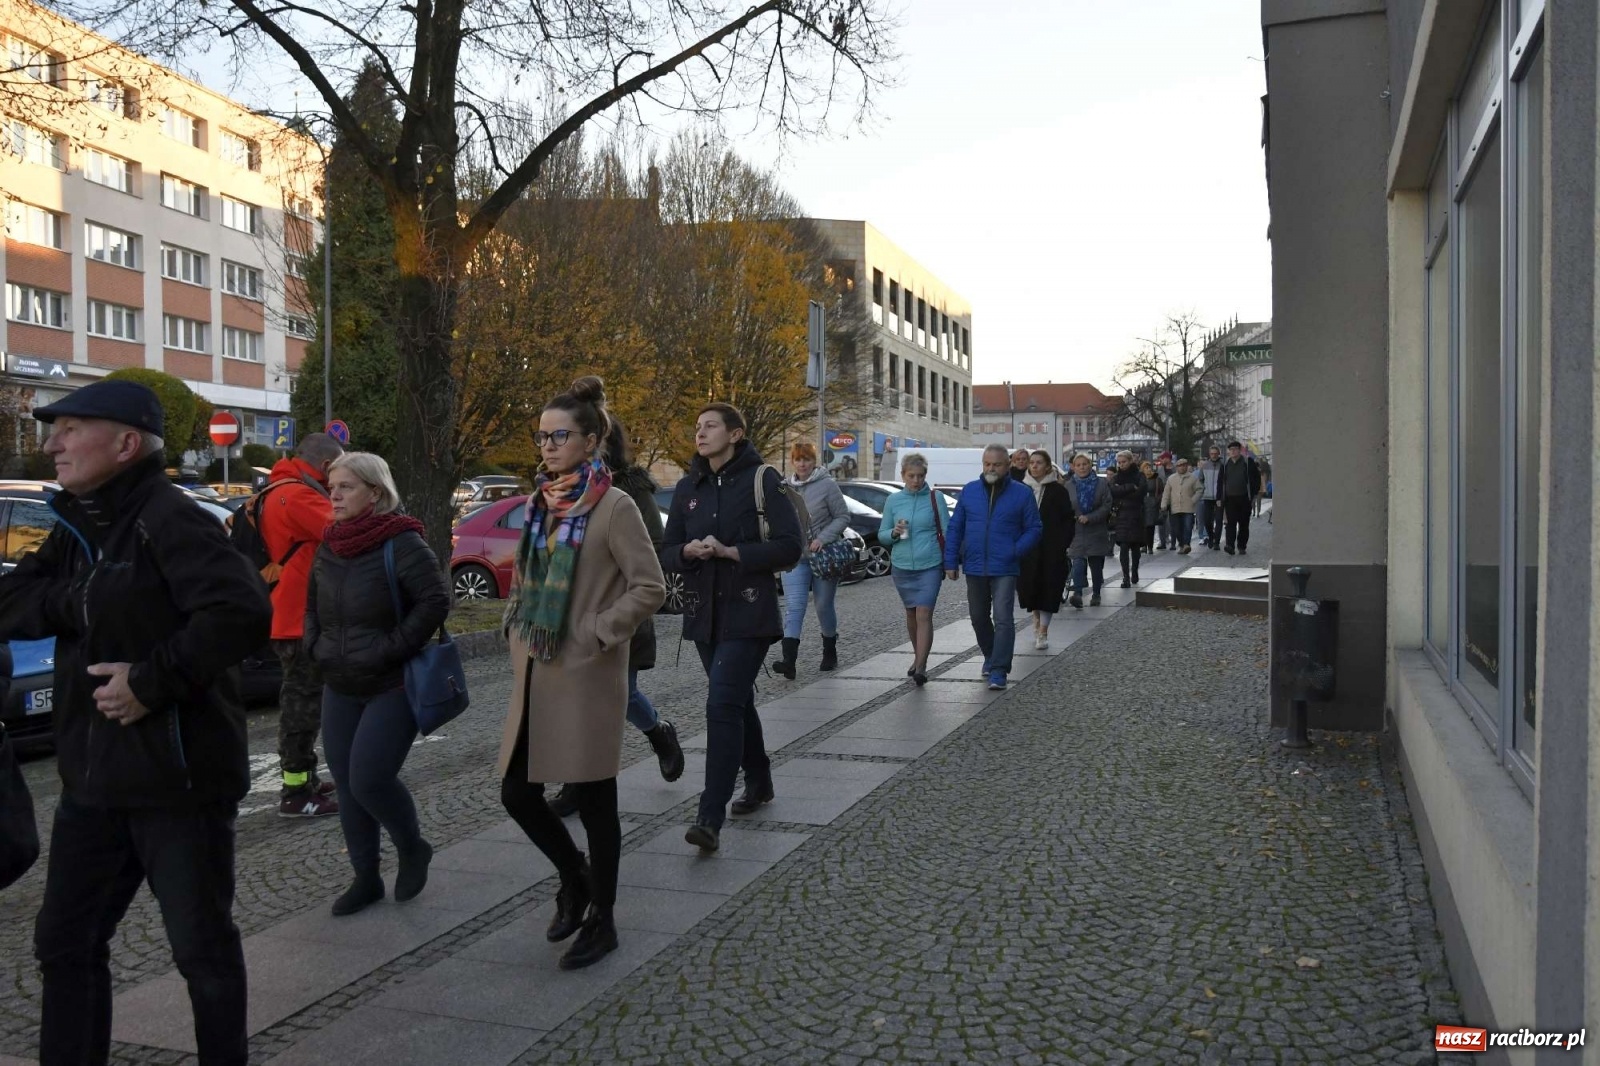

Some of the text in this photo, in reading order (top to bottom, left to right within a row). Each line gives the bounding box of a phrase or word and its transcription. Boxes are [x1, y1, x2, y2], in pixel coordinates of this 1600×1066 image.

[278, 420, 288, 434] P
[832, 437, 854, 445] PEPCO
[1100, 459, 1106, 467] P
[258, 476, 264, 485] P
[301, 801, 320, 815] N
